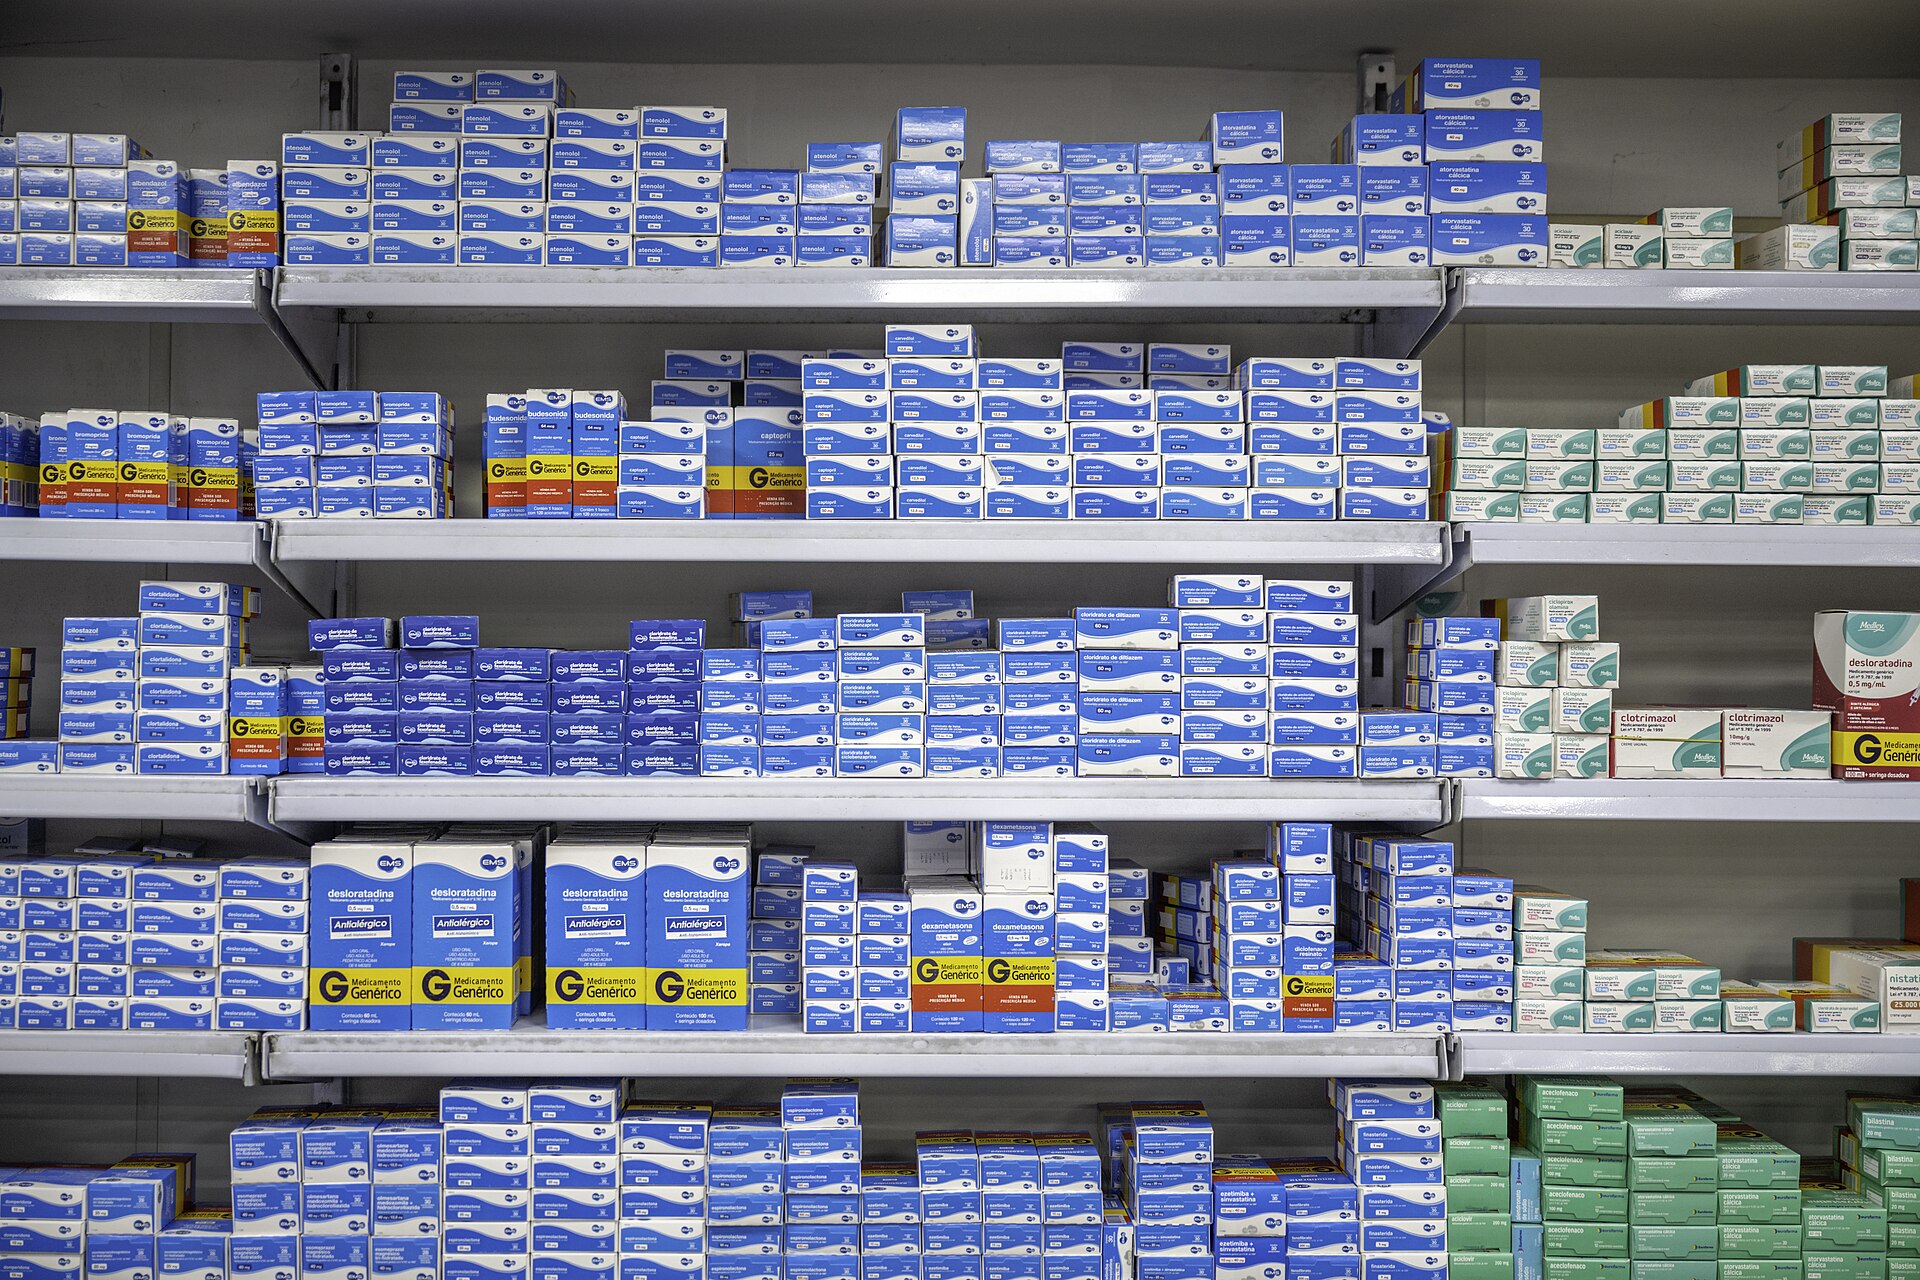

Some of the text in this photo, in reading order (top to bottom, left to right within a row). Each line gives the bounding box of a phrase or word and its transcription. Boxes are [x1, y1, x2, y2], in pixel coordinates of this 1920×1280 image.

[147, 220, 175, 228] Genérico
[86, 471, 115, 479] Genérico
[138, 472, 166, 480] Genérico
[749, 468, 768, 488] G
[769, 477, 803, 486] Genérico
[1850, 659, 1912, 668] desloratadina
[1621, 714, 1676, 722] clotrimazol
[1729, 714, 1784, 722] clotrimazol
[1854, 734, 1882, 764] G
[328, 890, 394, 898] desloratadina
[431, 889, 496, 897] desloratadina
[563, 889, 628, 897] desloratadina
[663, 890, 729, 898] desloratadina
[334, 919, 387, 929] Antialérgico
[569, 919, 621, 928] Antialérgico
[670, 919, 722, 929] Antialérgico
[941, 970, 979, 980] Genérico
[1012, 970, 1050, 981] Genérico
[352, 978, 401, 986] Medicamento
[454, 977, 503, 985] Medicamento
[320, 971, 348, 1002] G
[1305, 985, 1332, 994] Genérico
[351, 986, 401, 999] Genérico
[453, 985, 503, 998] Genérico
[587, 985, 636, 998] Genérico
[687, 987, 736, 999] Genérico
[1868, 1117, 1894, 1126] bilastina
